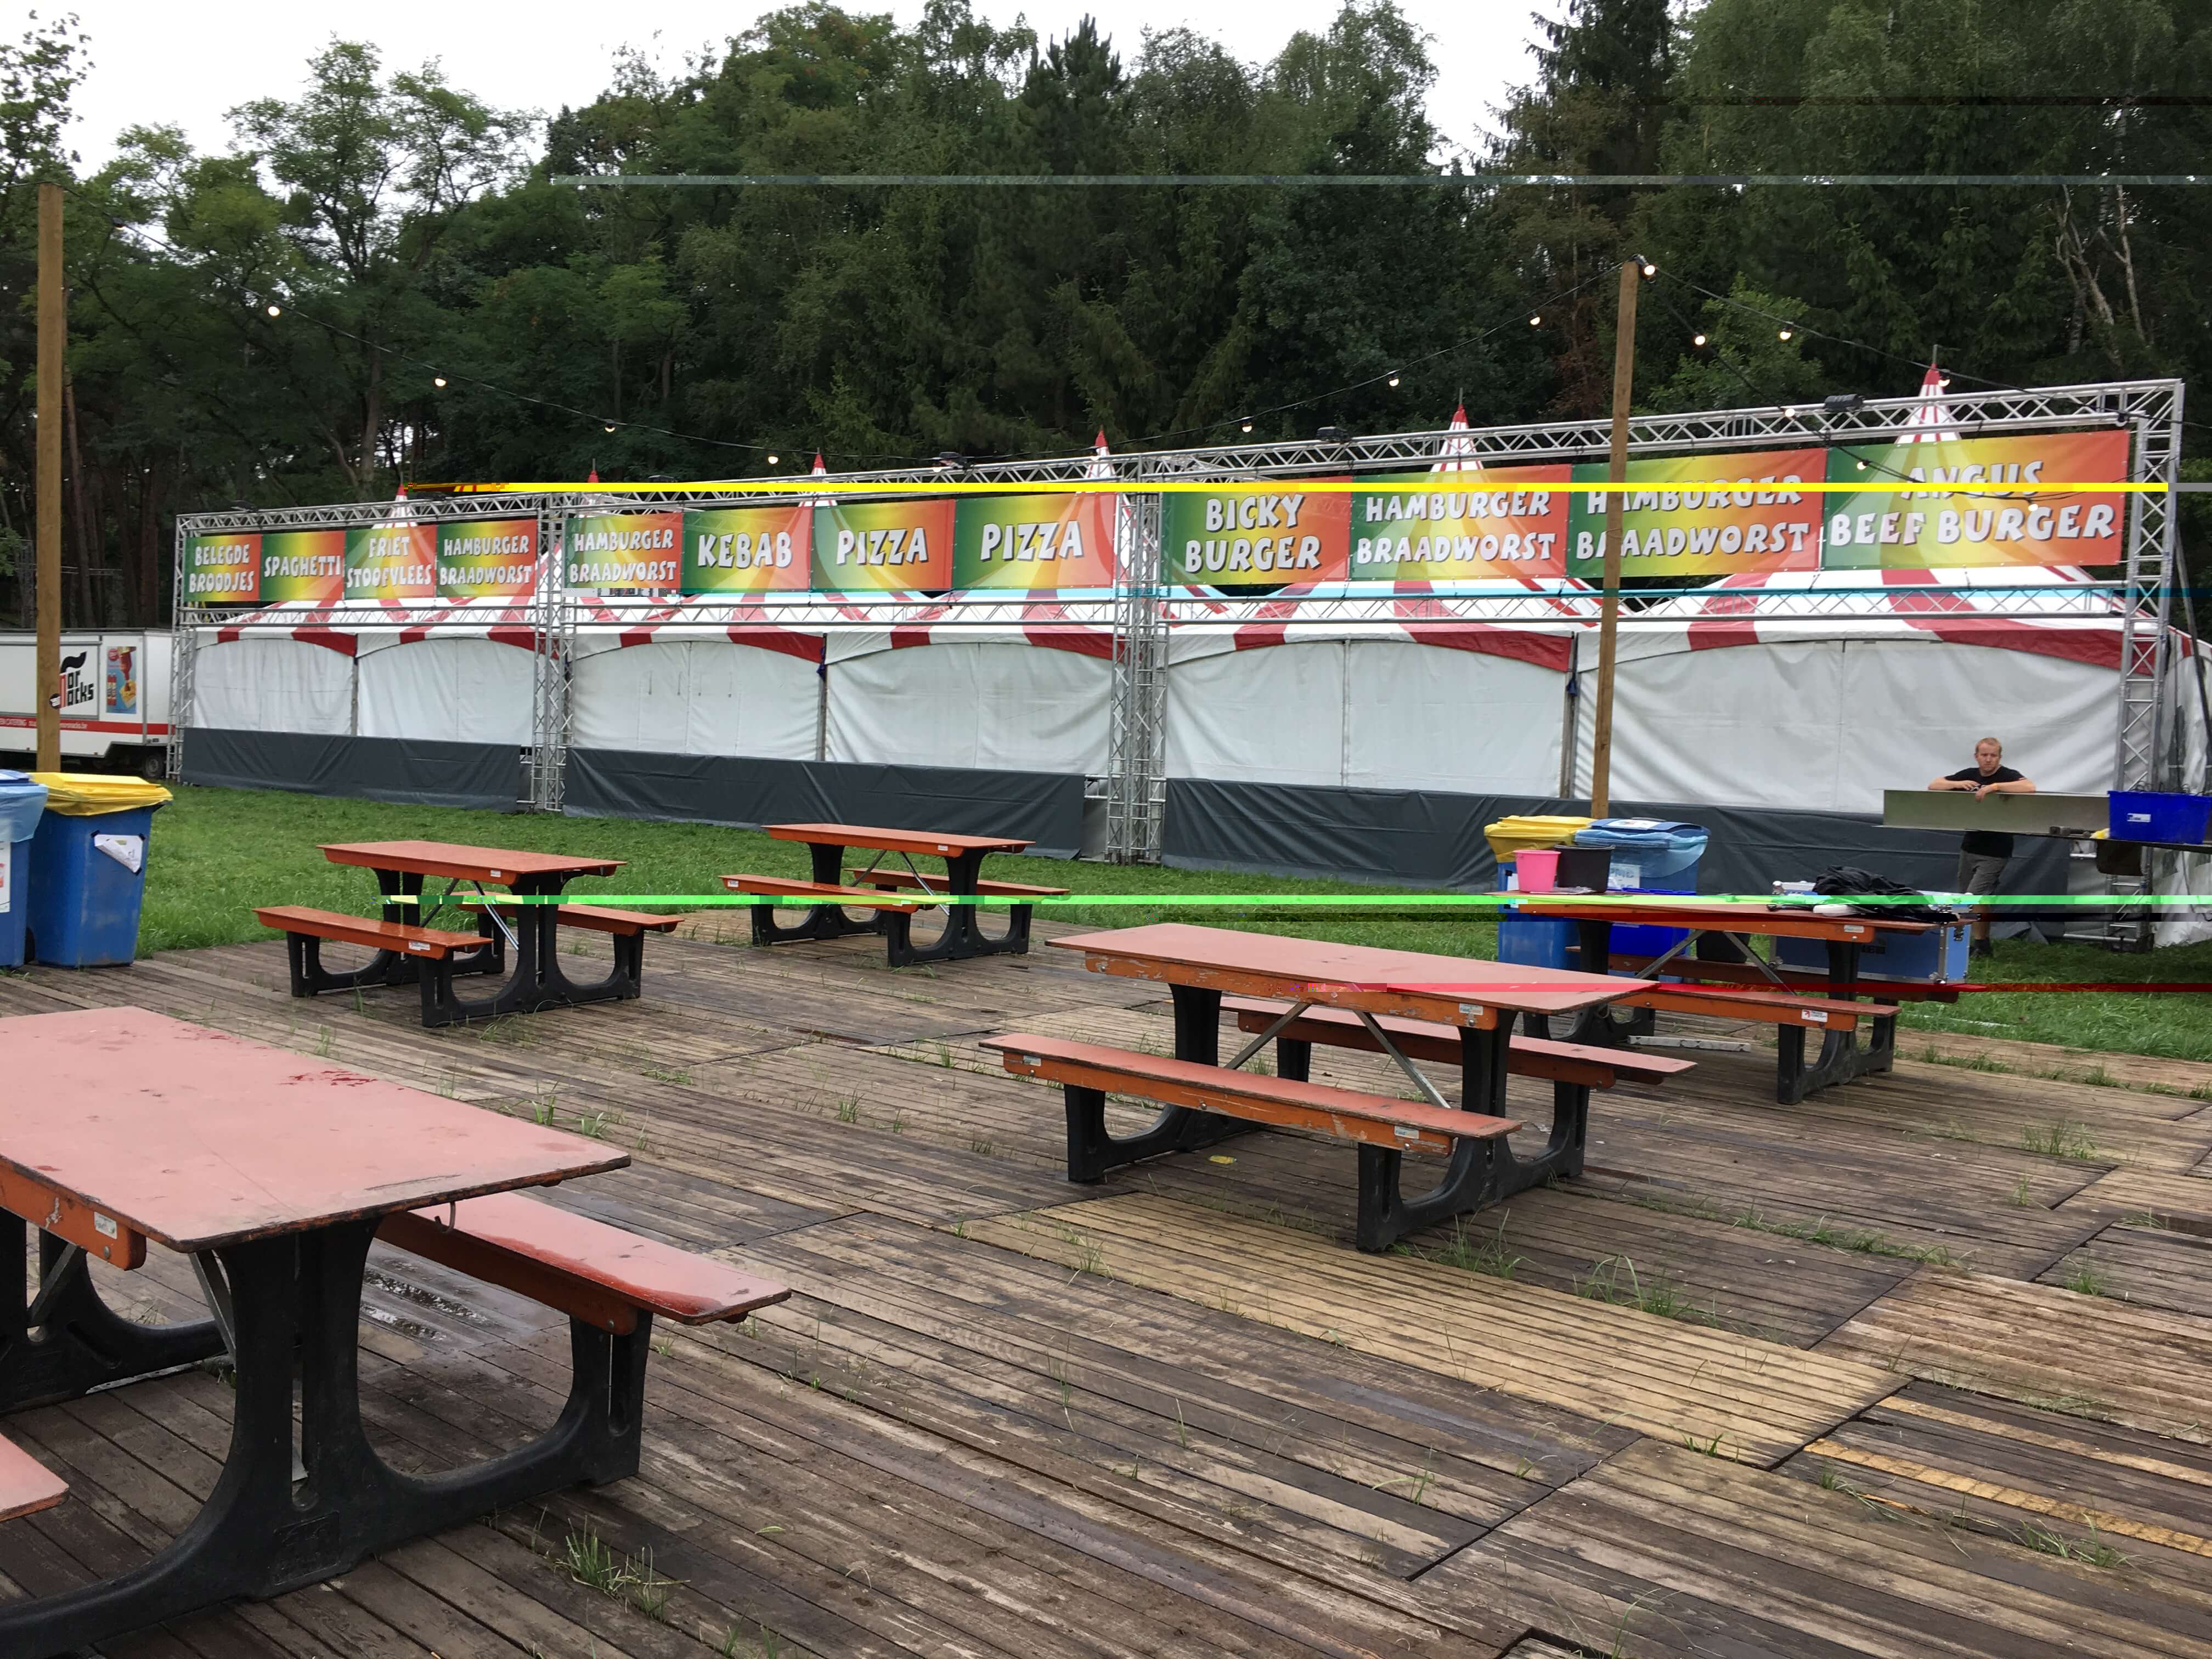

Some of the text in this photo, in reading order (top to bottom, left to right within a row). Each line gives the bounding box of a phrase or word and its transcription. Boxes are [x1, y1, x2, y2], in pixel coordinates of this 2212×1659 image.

[1205, 494, 1305, 532] BICKY
[1366, 490, 1551, 522] HAMBURGER
[1829, 504, 2116, 545] BEEF BURGER
[369, 535, 410, 558] FRIET
[443, 535, 529, 556] HAMBURGER
[574, 529, 674, 552] HAMBURGER
[697, 531, 792, 568] KEBAB
[836, 527, 929, 566] PIZZA
[979, 520, 1084, 562] PIZZA
[1357, 532, 1556, 565] BRAADWORST
[195, 544, 250, 566] BELEGDE
[264, 555, 341, 577] SPAGHETTI
[1185, 535, 1322, 573] BURGER
[189, 571, 255, 592] BROODJES
[346, 564, 431, 588] STOOFVLEES
[439, 565, 532, 585] BRAADWORST
[570, 561, 676, 583] BRAADWORST
